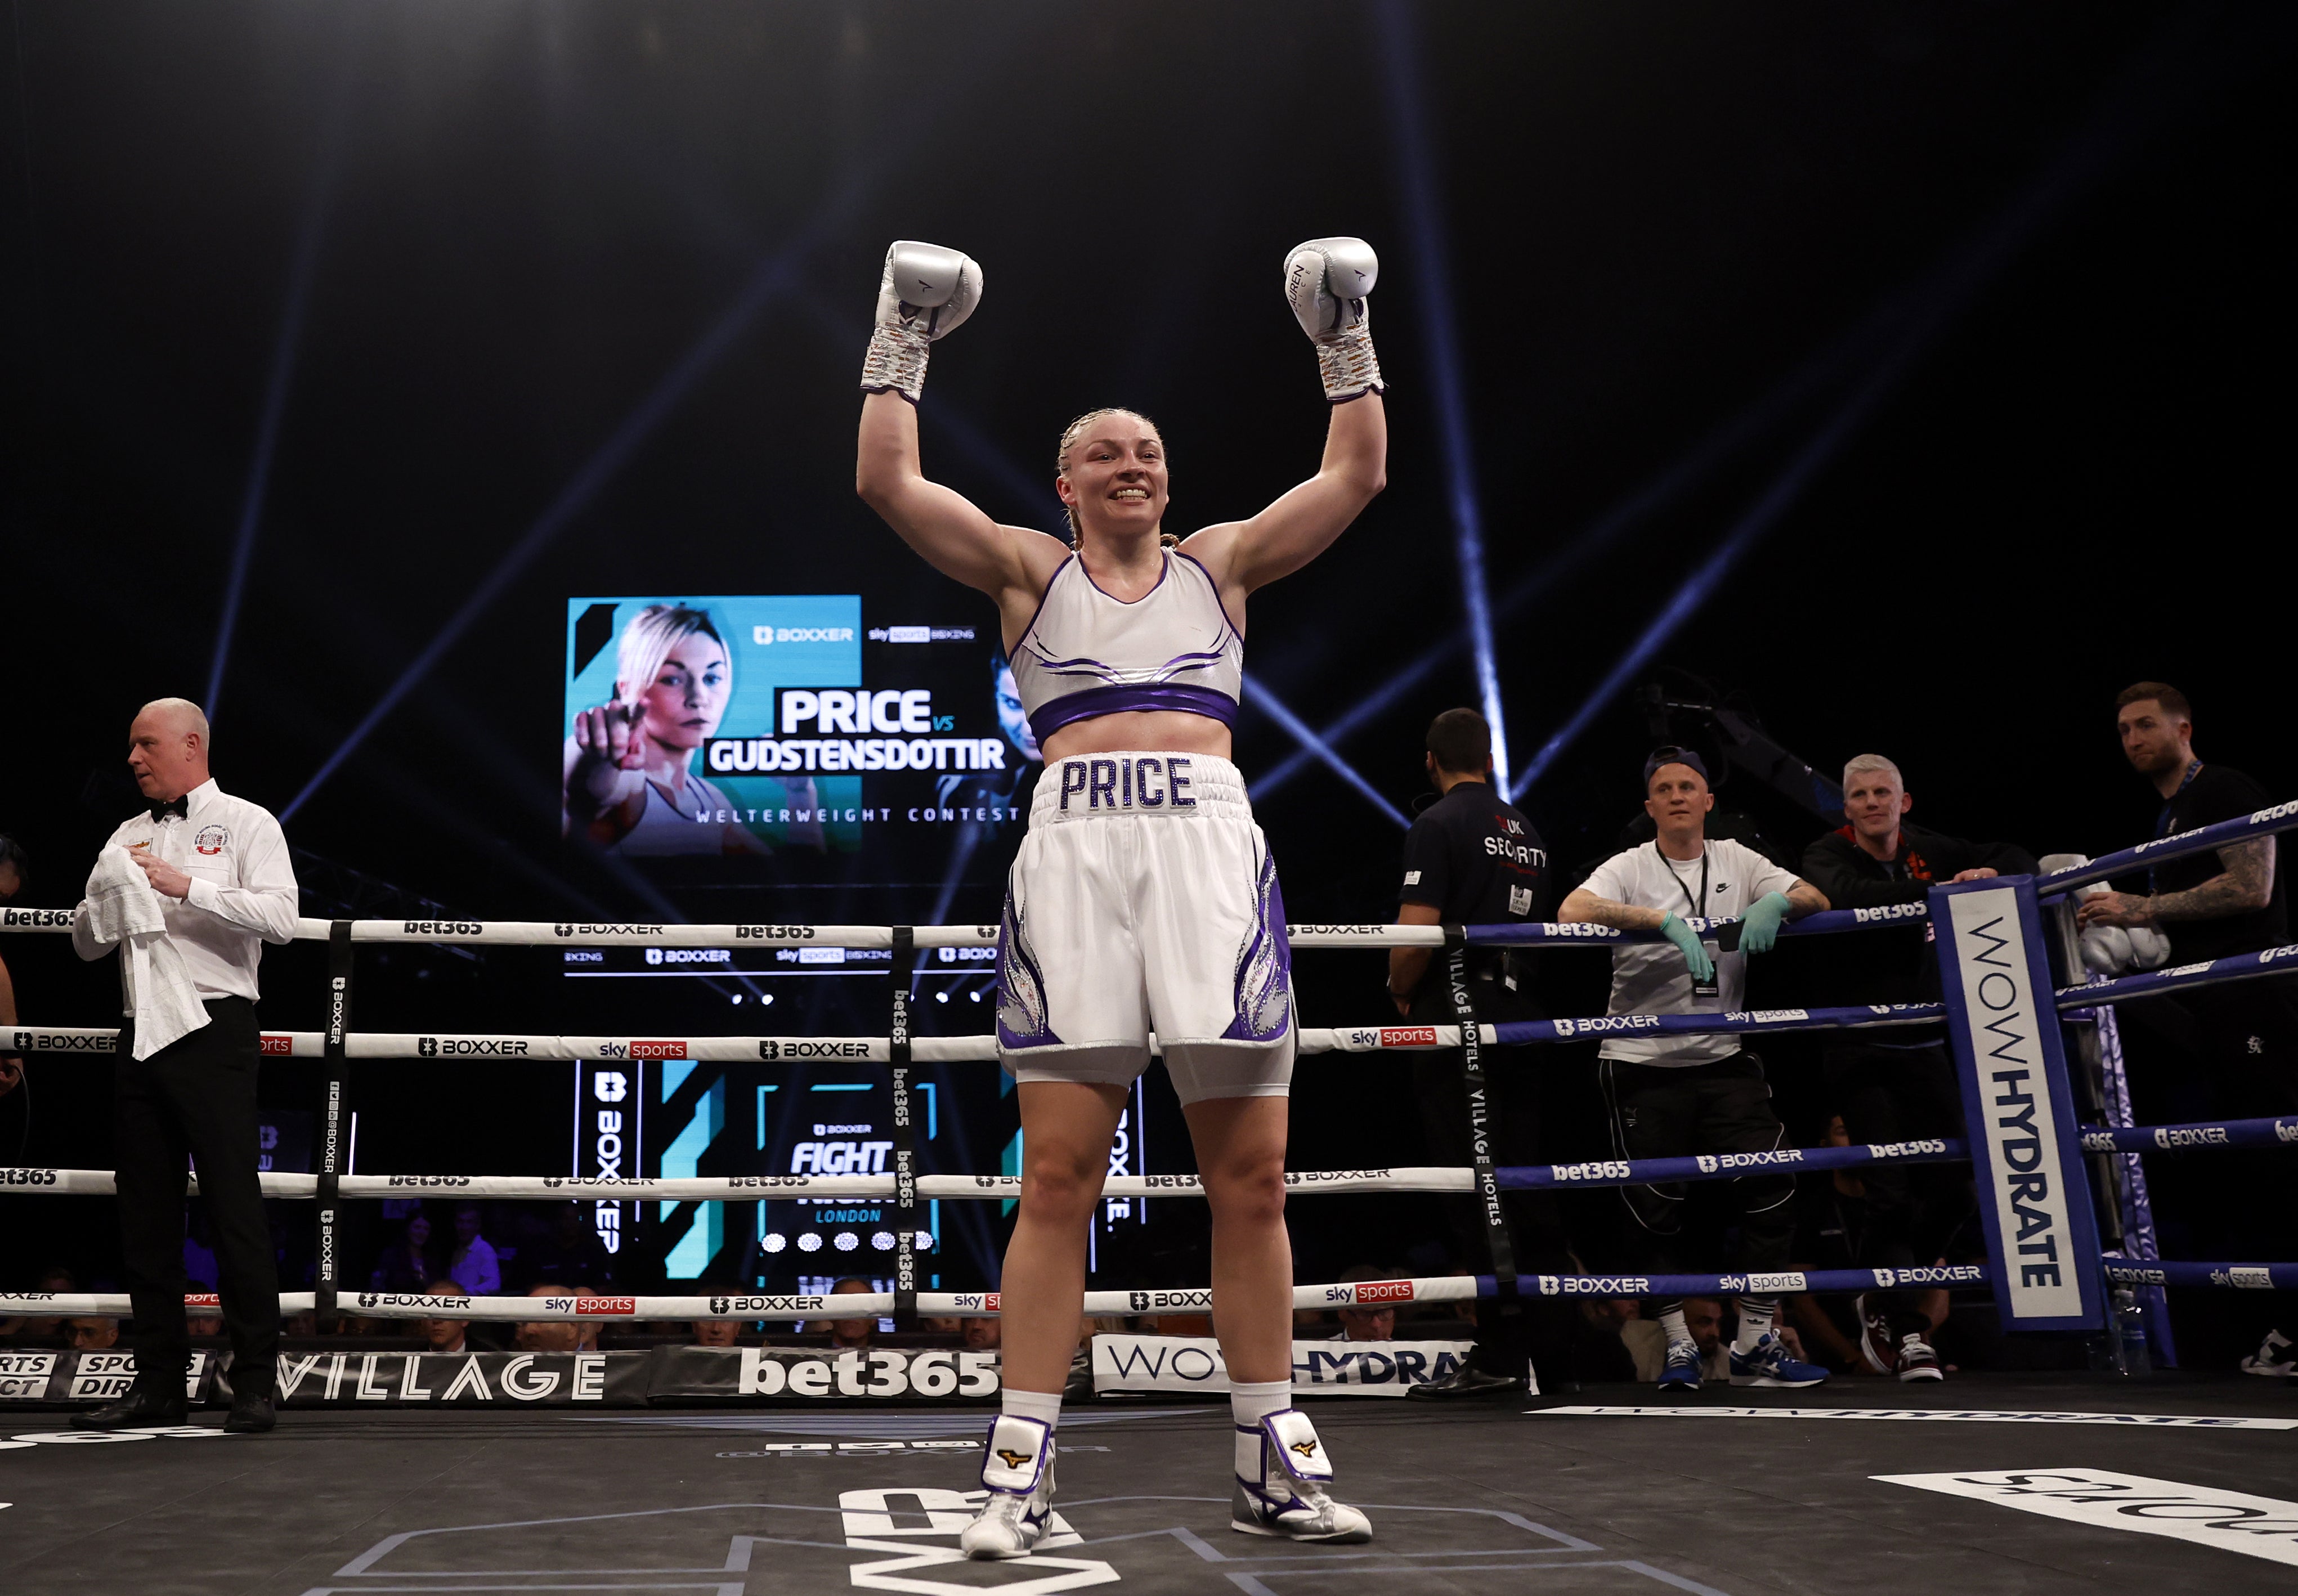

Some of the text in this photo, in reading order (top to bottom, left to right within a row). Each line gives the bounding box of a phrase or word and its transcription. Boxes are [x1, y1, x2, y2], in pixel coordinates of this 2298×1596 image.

[777, 628, 853, 642] BOXXER
[868, 627, 889, 643] sky
[782, 690, 930, 733] PRICE
[709, 739, 1006, 770] GUDSTENSDOTTIR
[1059, 757, 1197, 811] PRICE
[696, 808, 1019, 823] WELTERWEIGHT CONTEST
[1507, 819, 1525, 835] UK
[579, 924, 663, 934] BOXXER
[736, 925, 815, 939] bet365
[665, 950, 731, 963] BOXXER
[776, 948, 799, 963] sky
[1450, 948, 1472, 1014] VILLAGE
[330, 992, 343, 1044] BOXXER
[893, 990, 909, 1044] bet365
[1577, 1015, 1660, 1032] BOXXER
[1352, 1028, 1434, 1047] sky sports
[1463, 1020, 1479, 1071] HOTELS
[443, 1040, 528, 1055] BOXXER
[600, 1042, 684, 1059] sky sports
[784, 1043, 870, 1057] BOXXER
[893, 1069, 910, 1126] bet365
[1968, 916, 2061, 1288] WOWHYDRATE
[1470, 1088, 1490, 1164] VILLAGE
[2170, 1128, 2229, 1146] BOXXER
[324, 1120, 337, 1174] @BOXXER
[1868, 1138, 1946, 1158] bet365
[790, 1141, 894, 1173] FIGHT
[1721, 1149, 1804, 1169] BOXXER
[897, 1151, 913, 1208] bet365
[1553, 1160, 1631, 1181] bet365
[1482, 1173, 1502, 1226] HOTELS
[816, 1209, 881, 1223] LONDON
[321, 1226, 332, 1281] BOXXER
[899, 1232, 913, 1290] bet365
[1720, 1272, 1803, 1293] sky sports
[1897, 1266, 1983, 1284] BOXXER
[2112, 1267, 2169, 1285] BOXXER
[2210, 1269, 2232, 1287] sky
[1326, 1282, 1410, 1303] sky sports
[1564, 1277, 1650, 1293] BOXXER
[383, 1295, 471, 1309] BOXXER
[545, 1297, 632, 1313] sky sports
[735, 1297, 823, 1310] BOXXER
[955, 1294, 982, 1308] sky
[277, 1353, 607, 1402] VILLAGE
[739, 1347, 999, 1397] bet365
